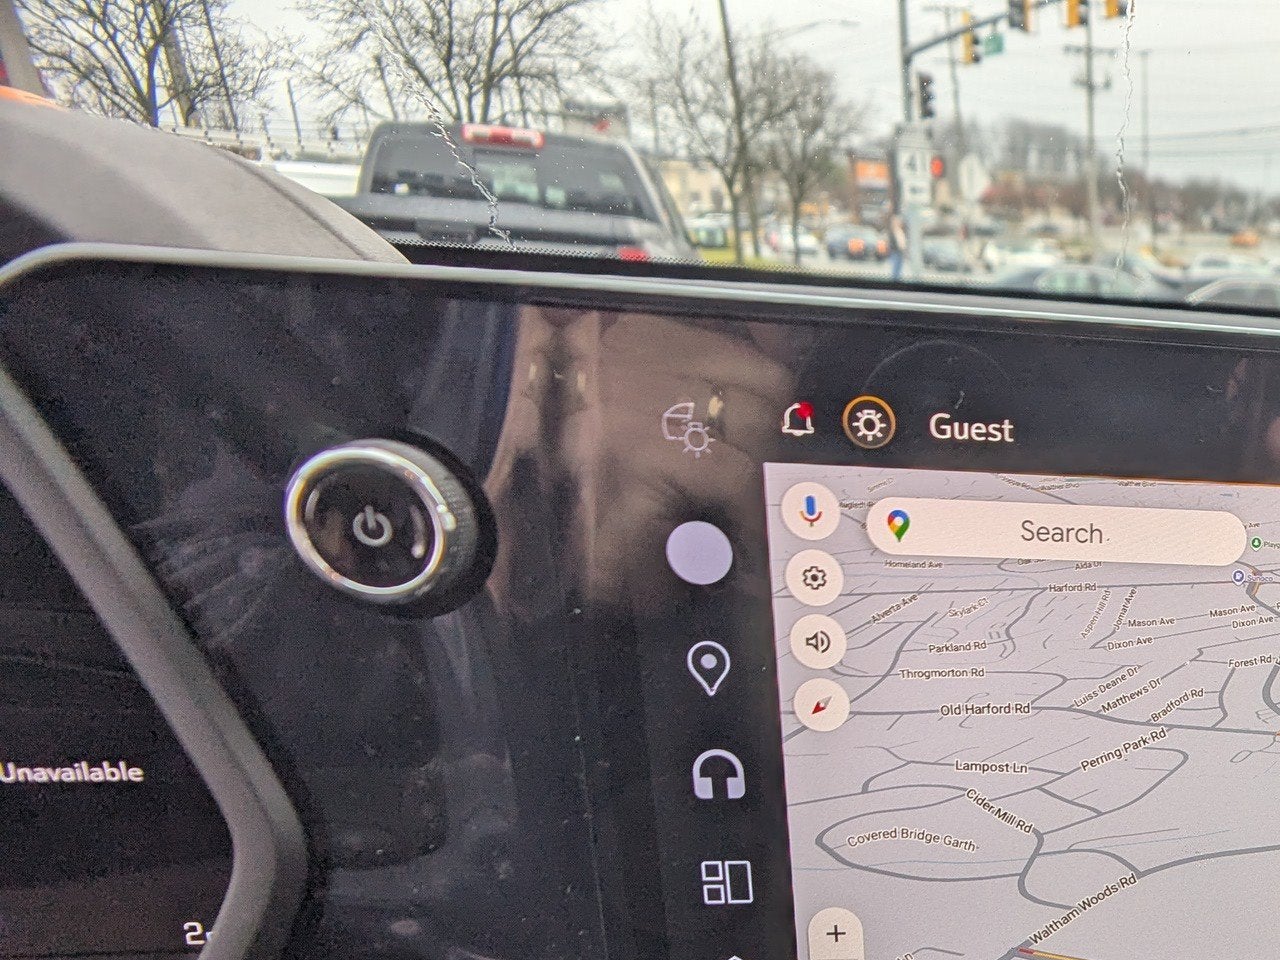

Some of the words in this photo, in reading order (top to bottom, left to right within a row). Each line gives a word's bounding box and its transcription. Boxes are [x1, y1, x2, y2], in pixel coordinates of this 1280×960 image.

[930, 413, 1014, 443] Guest
[1021, 519, 1104, 544] Search
[884, 560, 927, 569] Homeland
[928, 561, 943, 569] Ave
[1049, 583, 1084, 592] Harford
[1085, 582, 1097, 591] Rd
[1247, 574, 1274, 582] Sunoco
[871, 601, 902, 624] Alverta
[900, 593, 919, 608] Ave
[948, 603, 978, 618] Skylark
[976, 597, 989, 609] Ct
[1081, 615, 1099, 639] Aspen
[1096, 599, 1108, 617] Hill
[1102, 589, 1112, 602] Rd
[1114, 603, 1131, 632] Jomat
[1124, 586, 1138, 605] Ave
[1209, 606, 1239, 618] Mason
[1239, 603, 1257, 613] Ave
[1128, 619, 1157, 627] Mason
[1159, 616, 1176, 625] Ave
[1232, 617, 1258, 629] Dixon
[1258, 615, 1274, 625] Ave
[929, 642, 973, 655] Parkland
[973, 639, 988, 651] Rd
[1107, 639, 1135, 651] Dixon
[1135, 635, 1154, 646] Ave
[1228, 657, 1258, 668] Forest
[1258, 655, 1273, 666] Rd
[899, 667, 967, 681] Throgmorton
[968, 667, 985, 678] Rd
[1074, 690, 1100, 708] Luiss
[1098, 673, 1128, 695] Deane
[1126, 666, 1140, 679] Dr
[1101, 686, 1149, 713] Matthews
[1148, 676, 1162, 690] Dr
[940, 704, 963, 716] Old
[964, 702, 1012, 716] Harford
[1014, 702, 1032, 714] Rd
[1150, 693, 1190, 723] Bradford
[1189, 687, 1205, 700] Rd
[1080, 744, 1124, 771] Perring
[1122, 735, 1150, 756] Park
[1149, 726, 1168, 743] Rd
[0, 760, 144, 784] Unavailable
[954, 759, 1011, 775] Lampost
[1012, 762, 1028, 774] Ln
[966, 787, 996, 815] Cider
[994, 806, 1018, 826] Mill
[1016, 817, 1033, 834] Rd
[847, 827, 898, 848] Covered
[900, 827, 941, 844] Bridge
[943, 833, 977, 852] Garth
[1028, 907, 1081, 945] Waltham
[1077, 883, 1120, 912] Woods
[1118, 872, 1138, 890] Rd
[183, 922, 206, 946] 2
